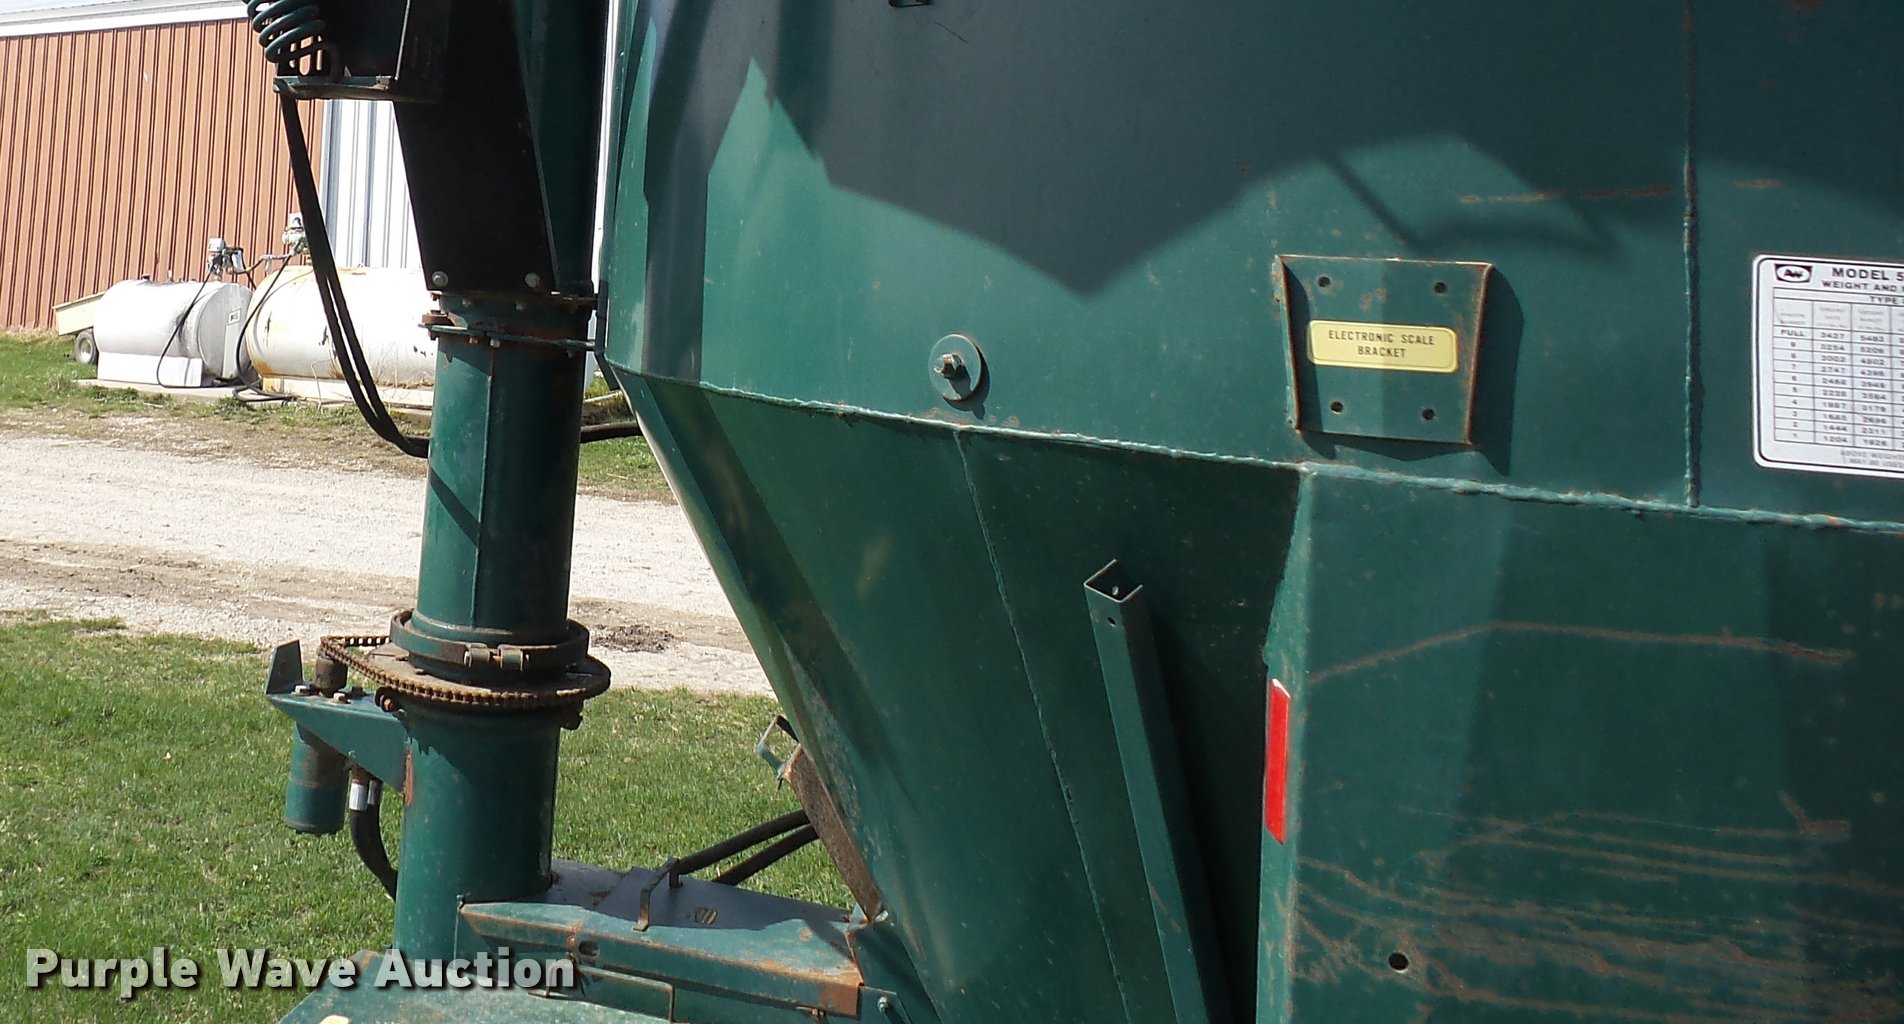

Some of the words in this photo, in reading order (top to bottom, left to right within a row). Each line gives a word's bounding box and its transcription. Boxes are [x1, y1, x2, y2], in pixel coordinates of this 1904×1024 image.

[1832, 267, 1890, 281] MODEL
[1821, 280, 1869, 290] WEIGHT
[1873, 284, 1897, 292] AND
[1869, 296, 1898, 305] TYPE
[1328, 329, 1394, 343] ELECTRONIC
[1400, 334, 1435, 346] SCALE
[1781, 329, 1805, 337] FULL
[1357, 345, 1406, 358] BRACKET
